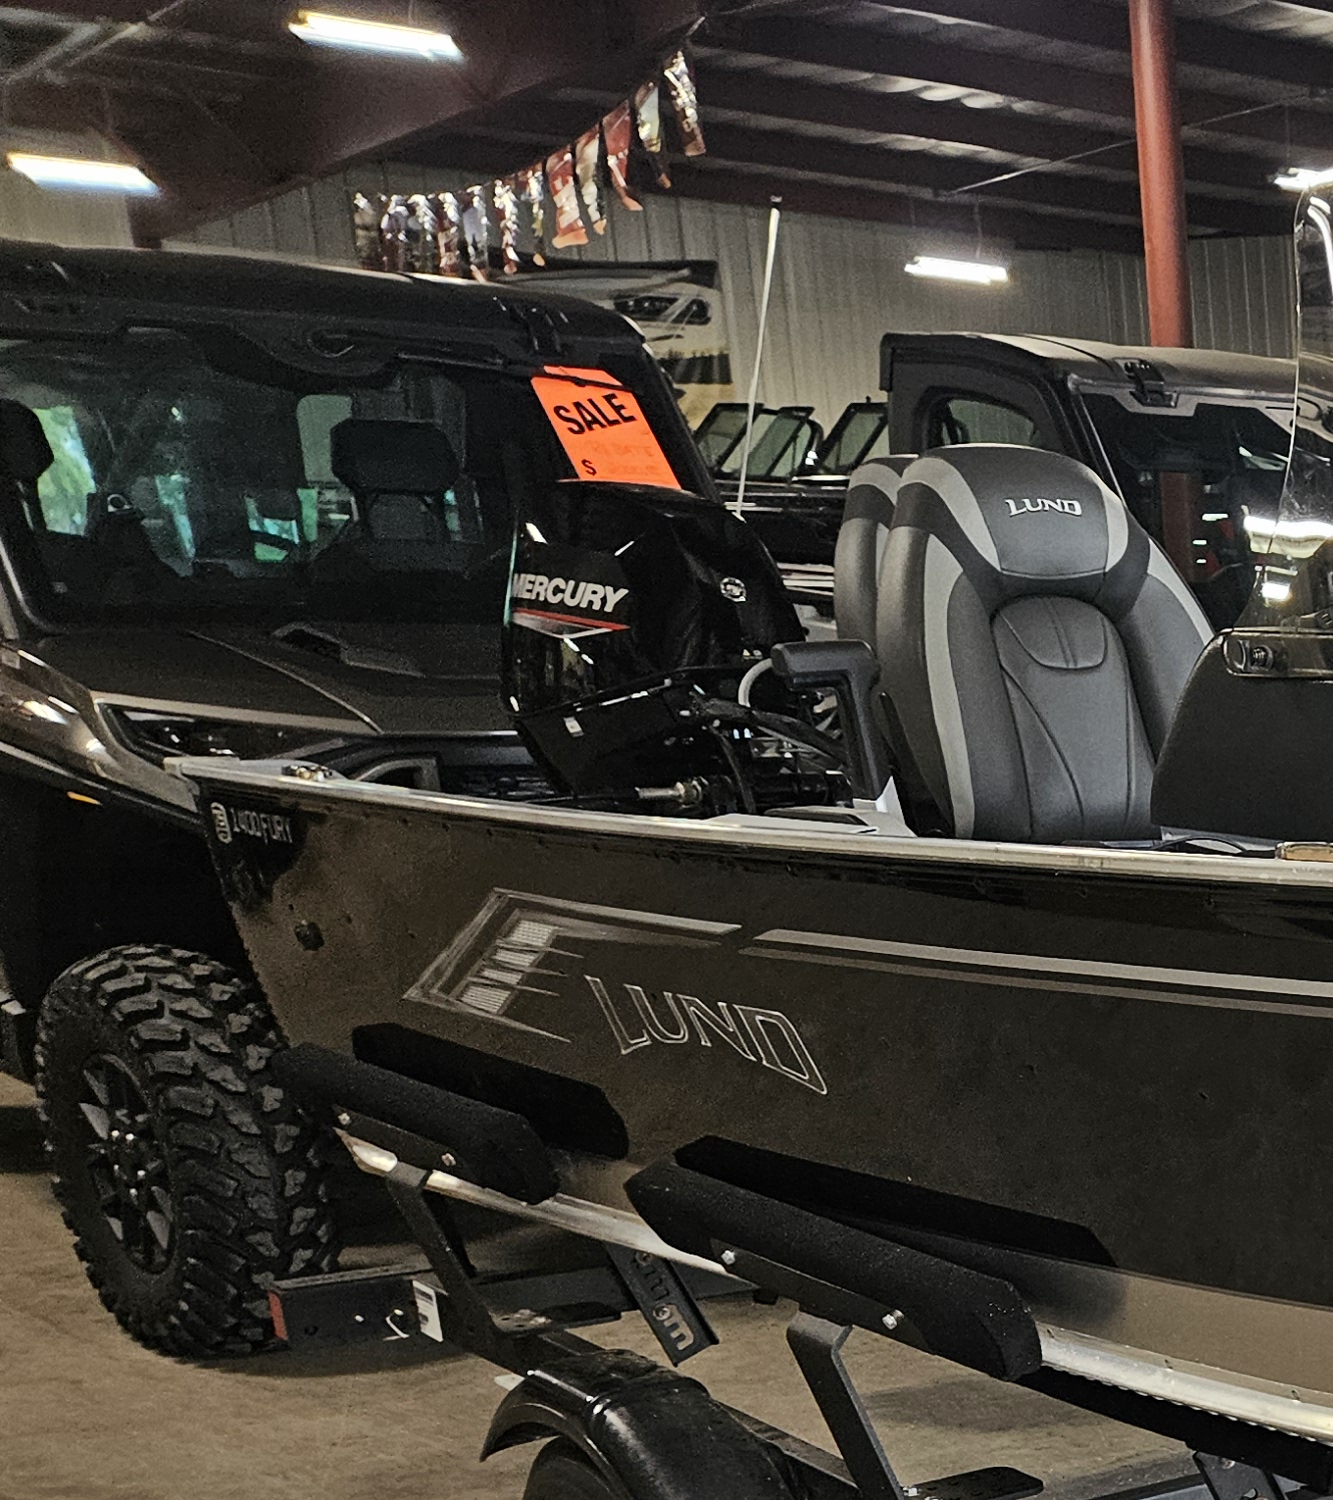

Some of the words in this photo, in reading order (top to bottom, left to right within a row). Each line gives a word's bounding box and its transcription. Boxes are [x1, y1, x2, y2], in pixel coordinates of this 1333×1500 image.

[553, 393, 637, 435] SALE
[1004, 498, 1083, 517] LUND
[512, 573, 629, 613] MERCURY
[584, 974, 828, 1095] LUND
